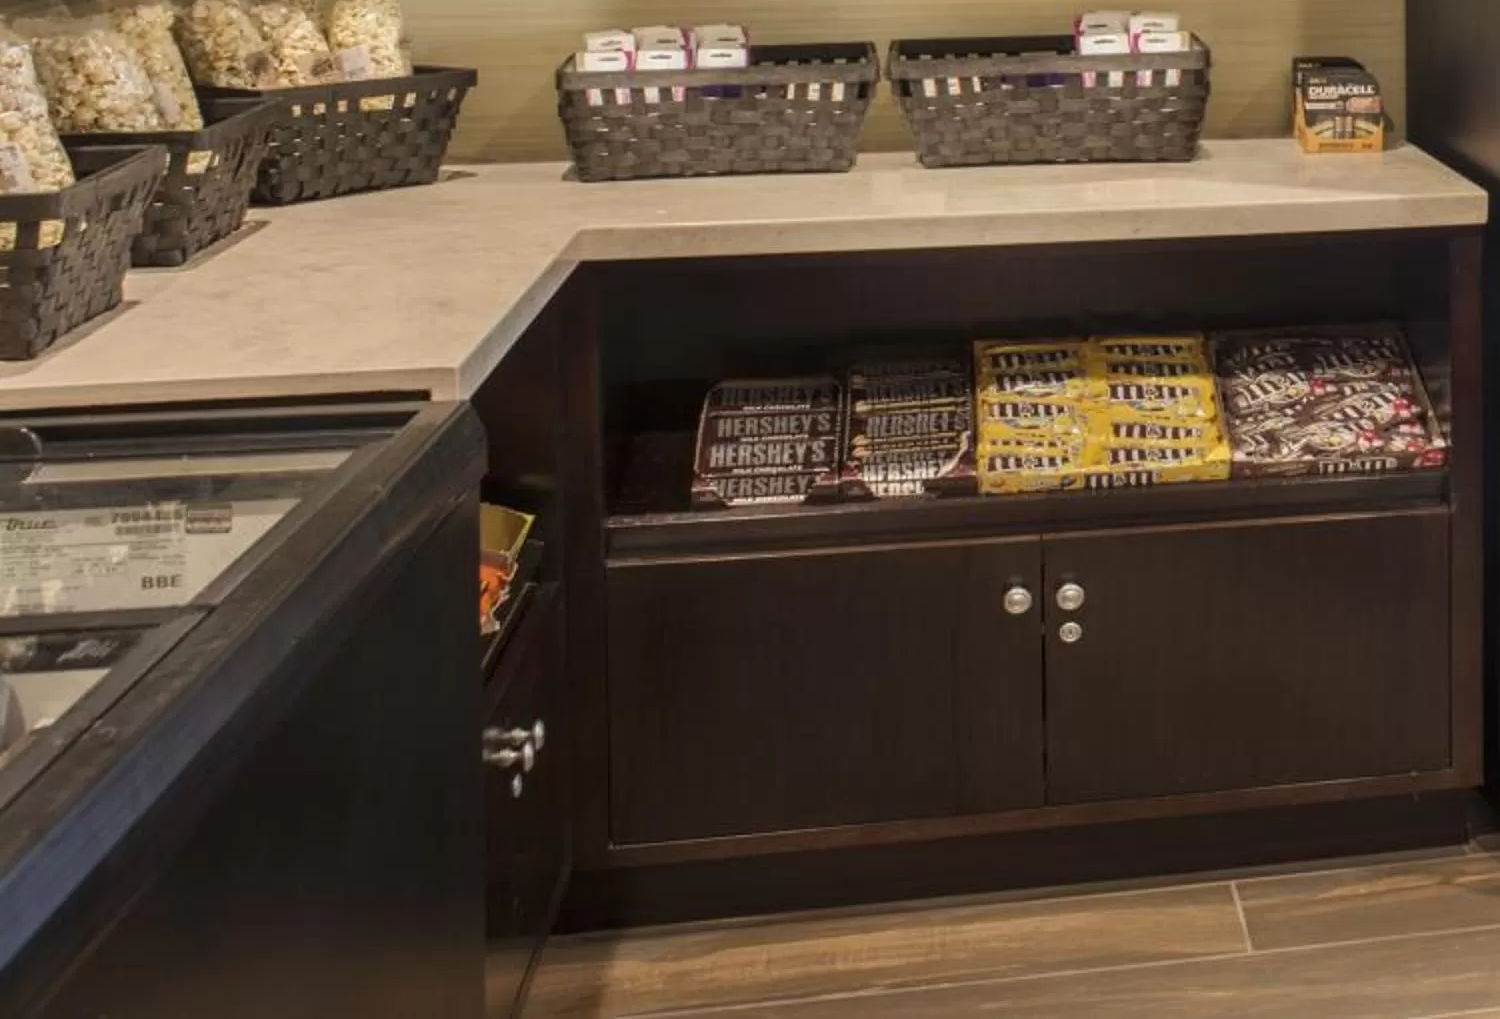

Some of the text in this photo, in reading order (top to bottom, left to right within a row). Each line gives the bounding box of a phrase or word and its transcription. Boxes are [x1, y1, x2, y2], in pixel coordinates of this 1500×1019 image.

[718, 412, 831, 438] HERSHEY'S
[710, 440, 826, 469] HERSHEY'S
[716, 472, 813, 497] HERSHEY
